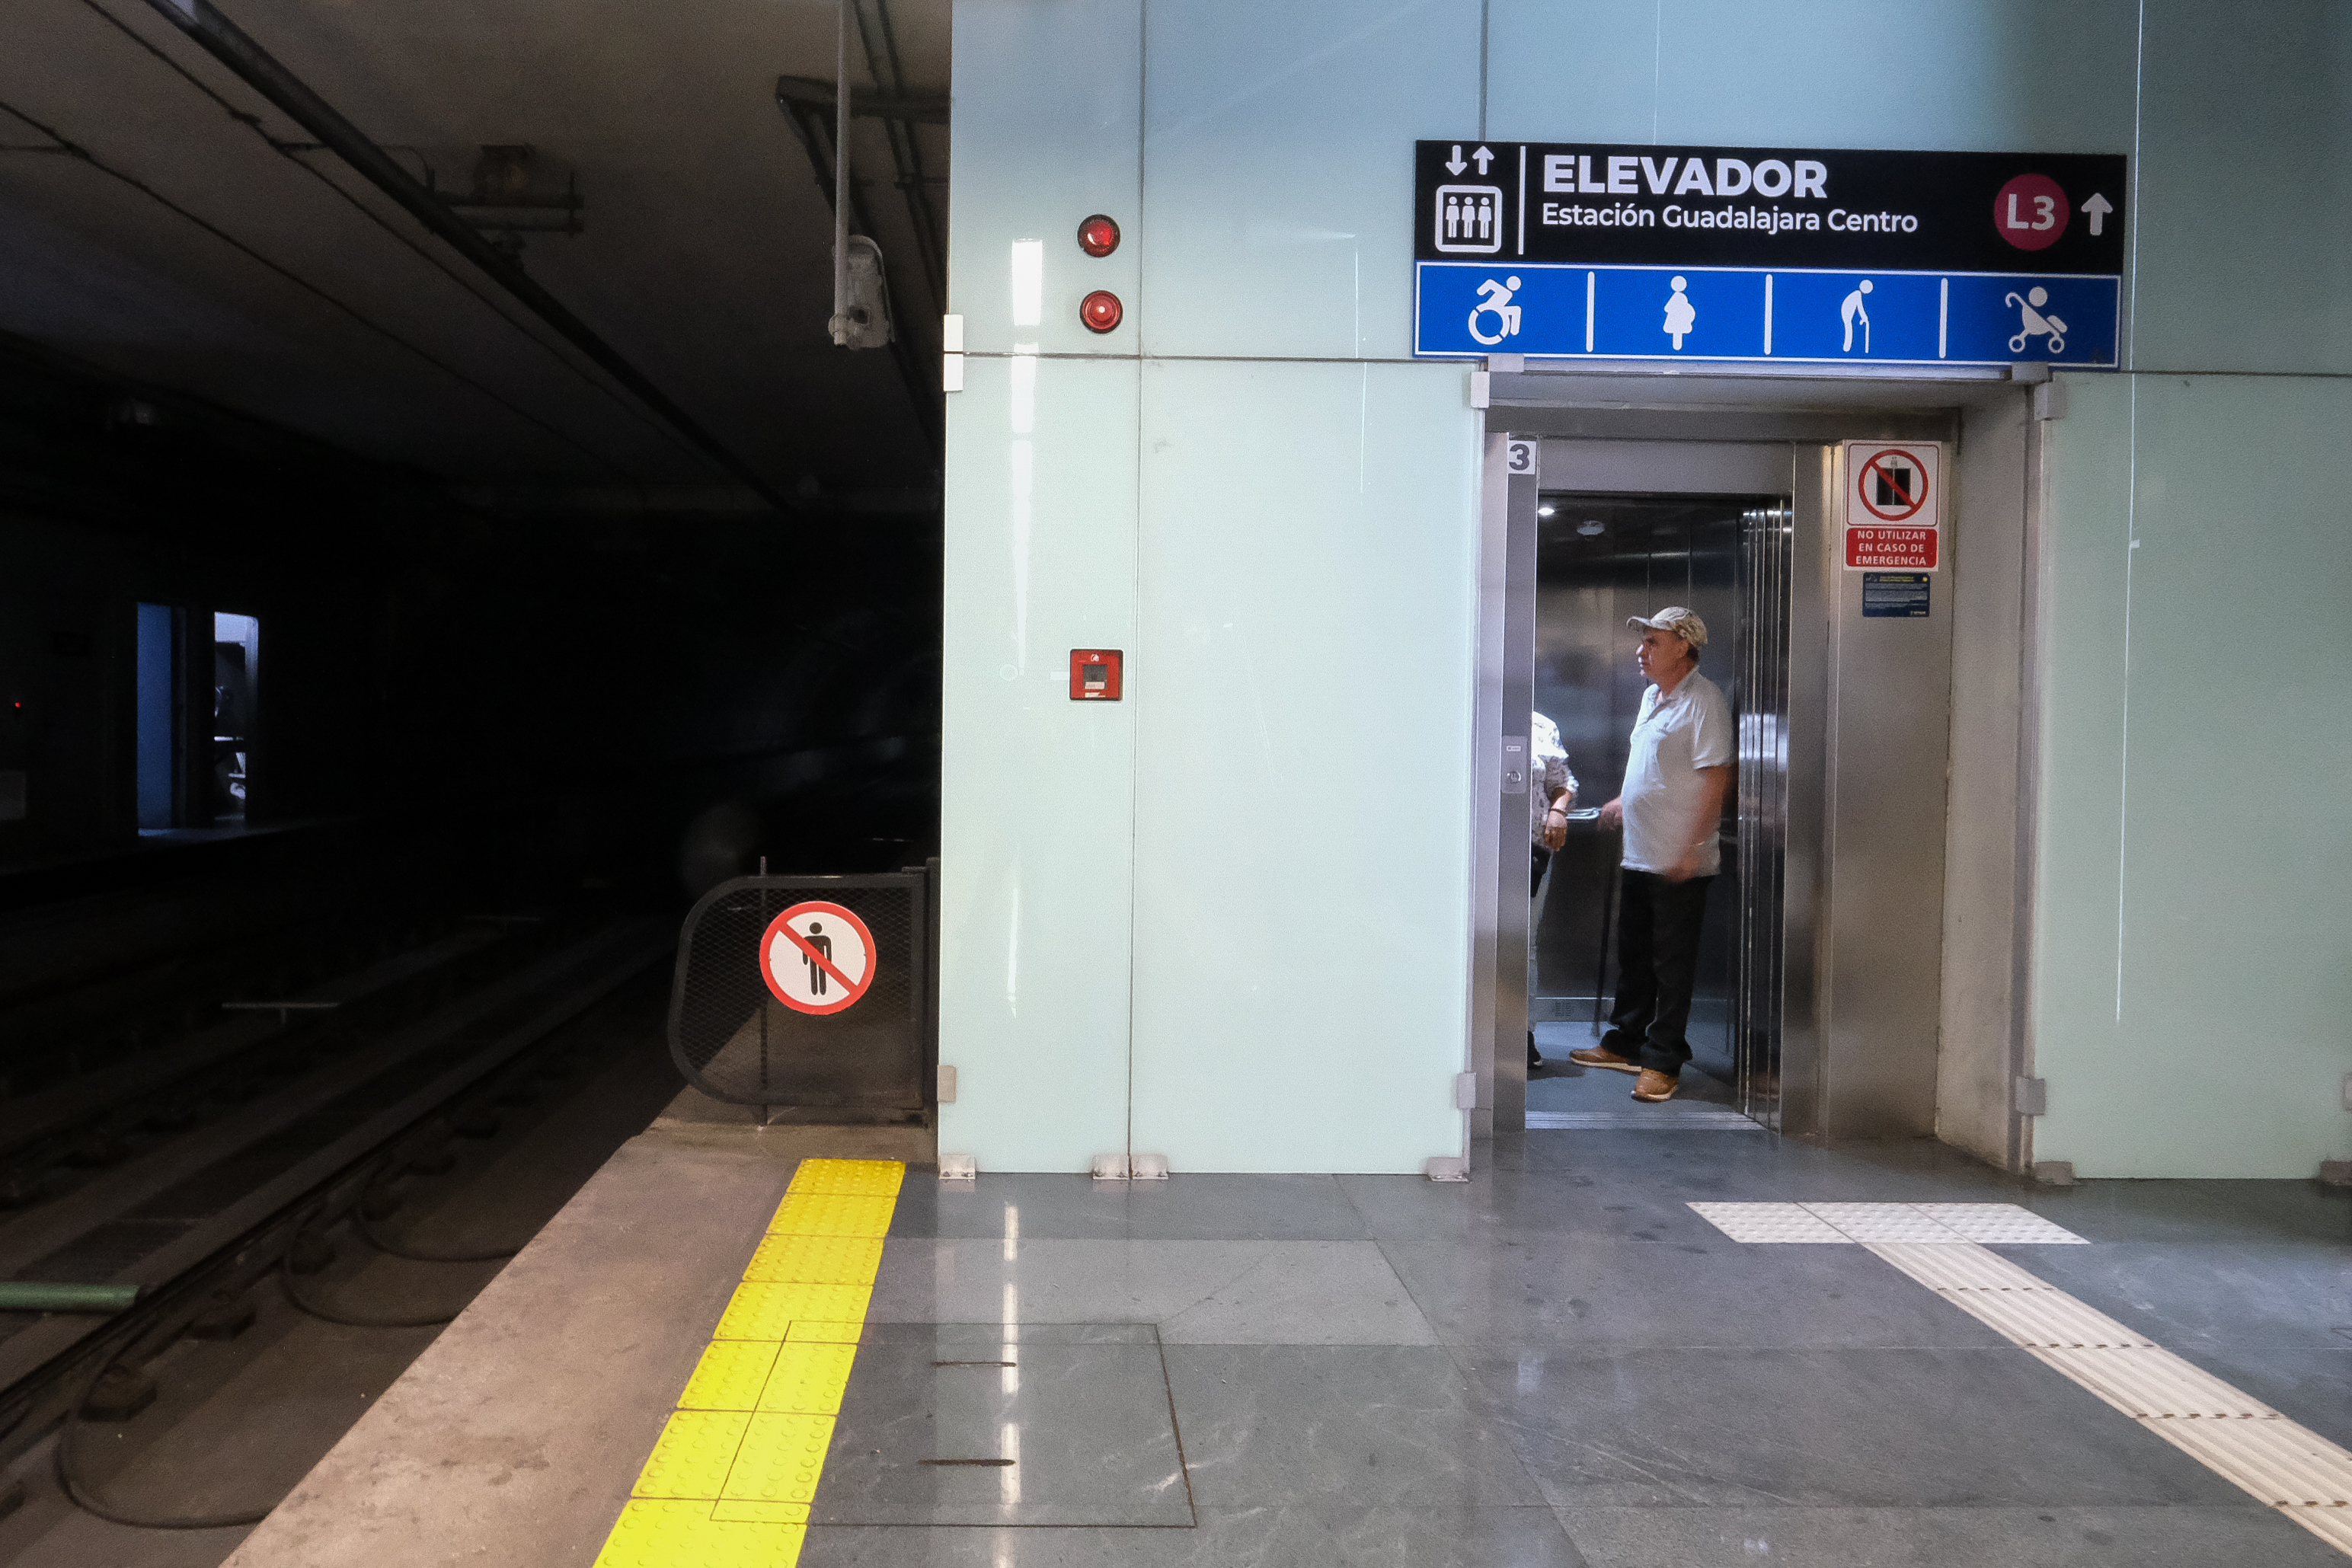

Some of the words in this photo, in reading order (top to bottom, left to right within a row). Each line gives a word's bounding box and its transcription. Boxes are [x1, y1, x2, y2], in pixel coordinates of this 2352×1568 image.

[1543, 154, 1828, 198] ELEVADOR
[1542, 203, 1655, 227] Estación
[1663, 205, 1820, 235] Guadalajara
[1828, 209, 1918, 232] Centro
[2007, 193, 2055, 231] L3
[1509, 443, 1530, 471] 3
[1857, 530, 1874, 540] NO
[1877, 531, 1926, 541] UTILIZAR
[1858, 542, 1873, 552] EN
[1877, 543, 1907, 553] CASO
[1910, 543, 1925, 553] DE
[1855, 555, 1926, 566] EMERGENCIA
